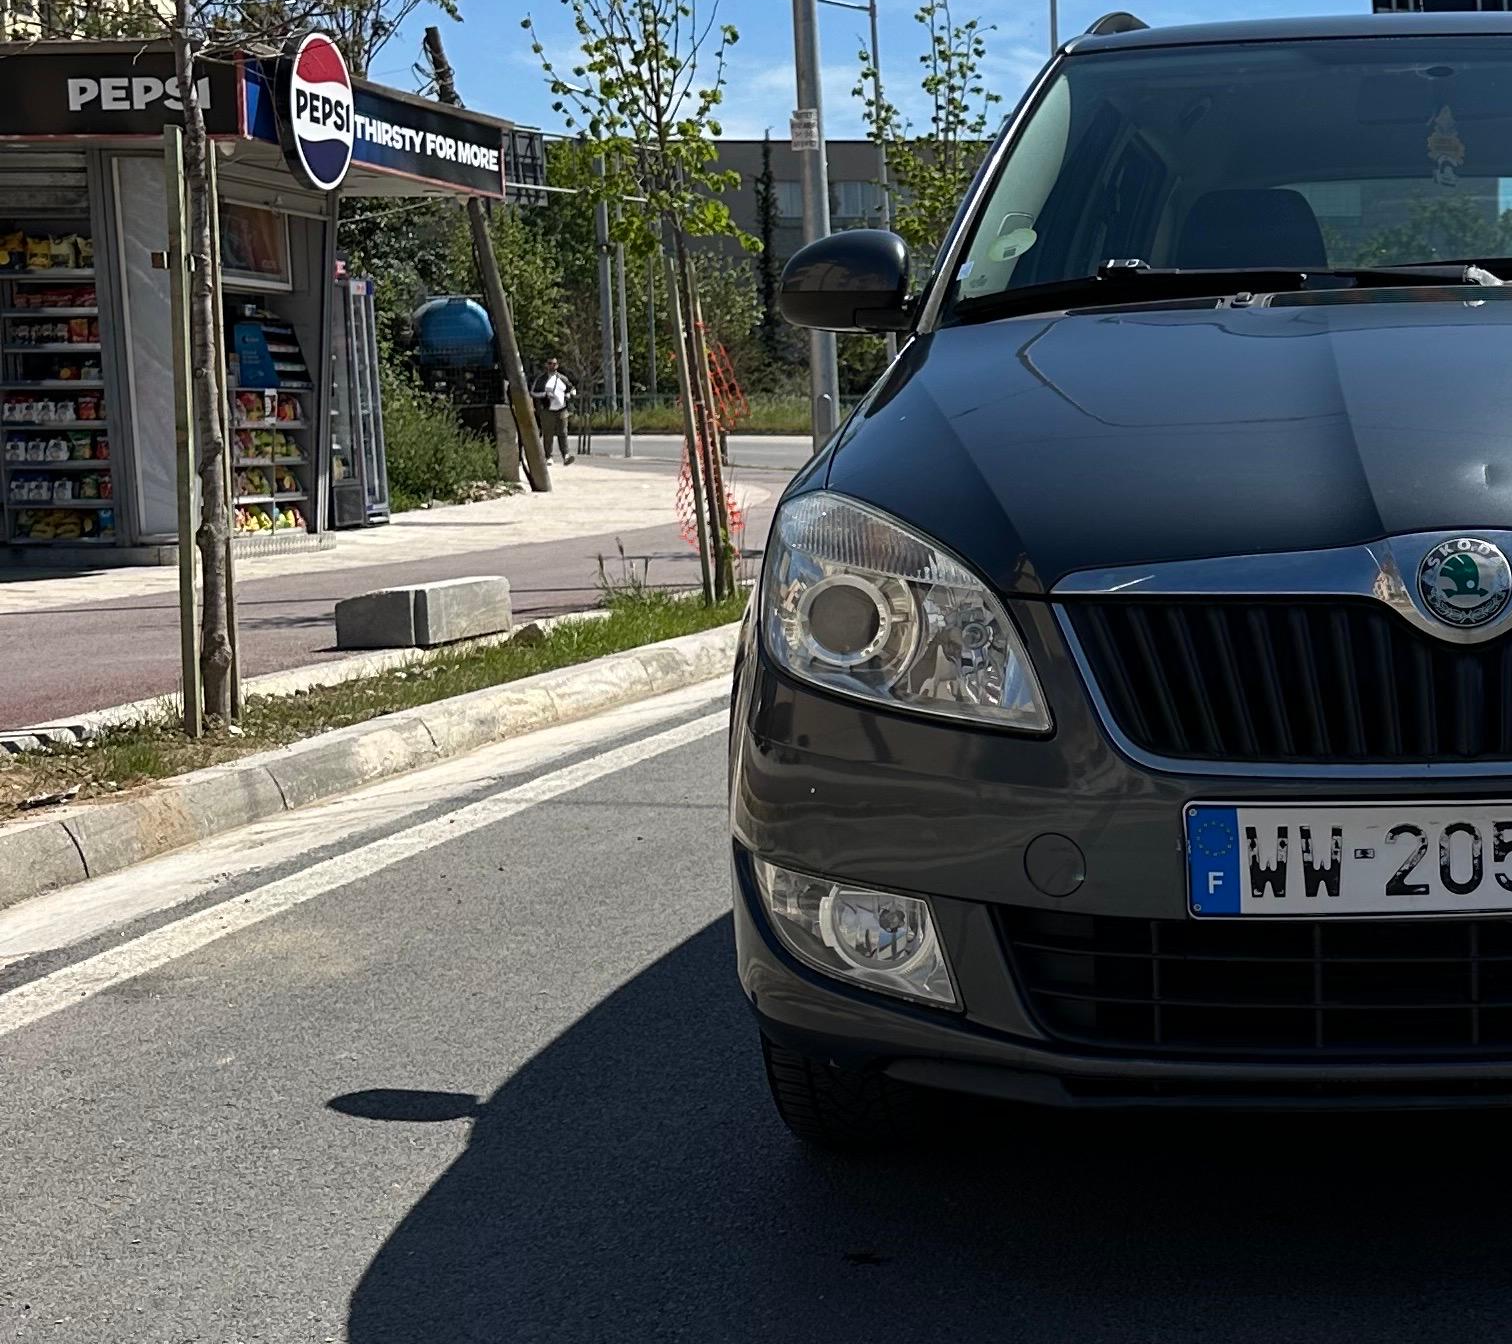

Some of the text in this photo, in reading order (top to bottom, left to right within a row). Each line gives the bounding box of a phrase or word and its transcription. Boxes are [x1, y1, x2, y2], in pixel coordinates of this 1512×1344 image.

[295, 88, 351, 133] PEPSI
[355, 114, 499, 171] THIRSTY FOR MORE
[1207, 871, 1224, 894] F
